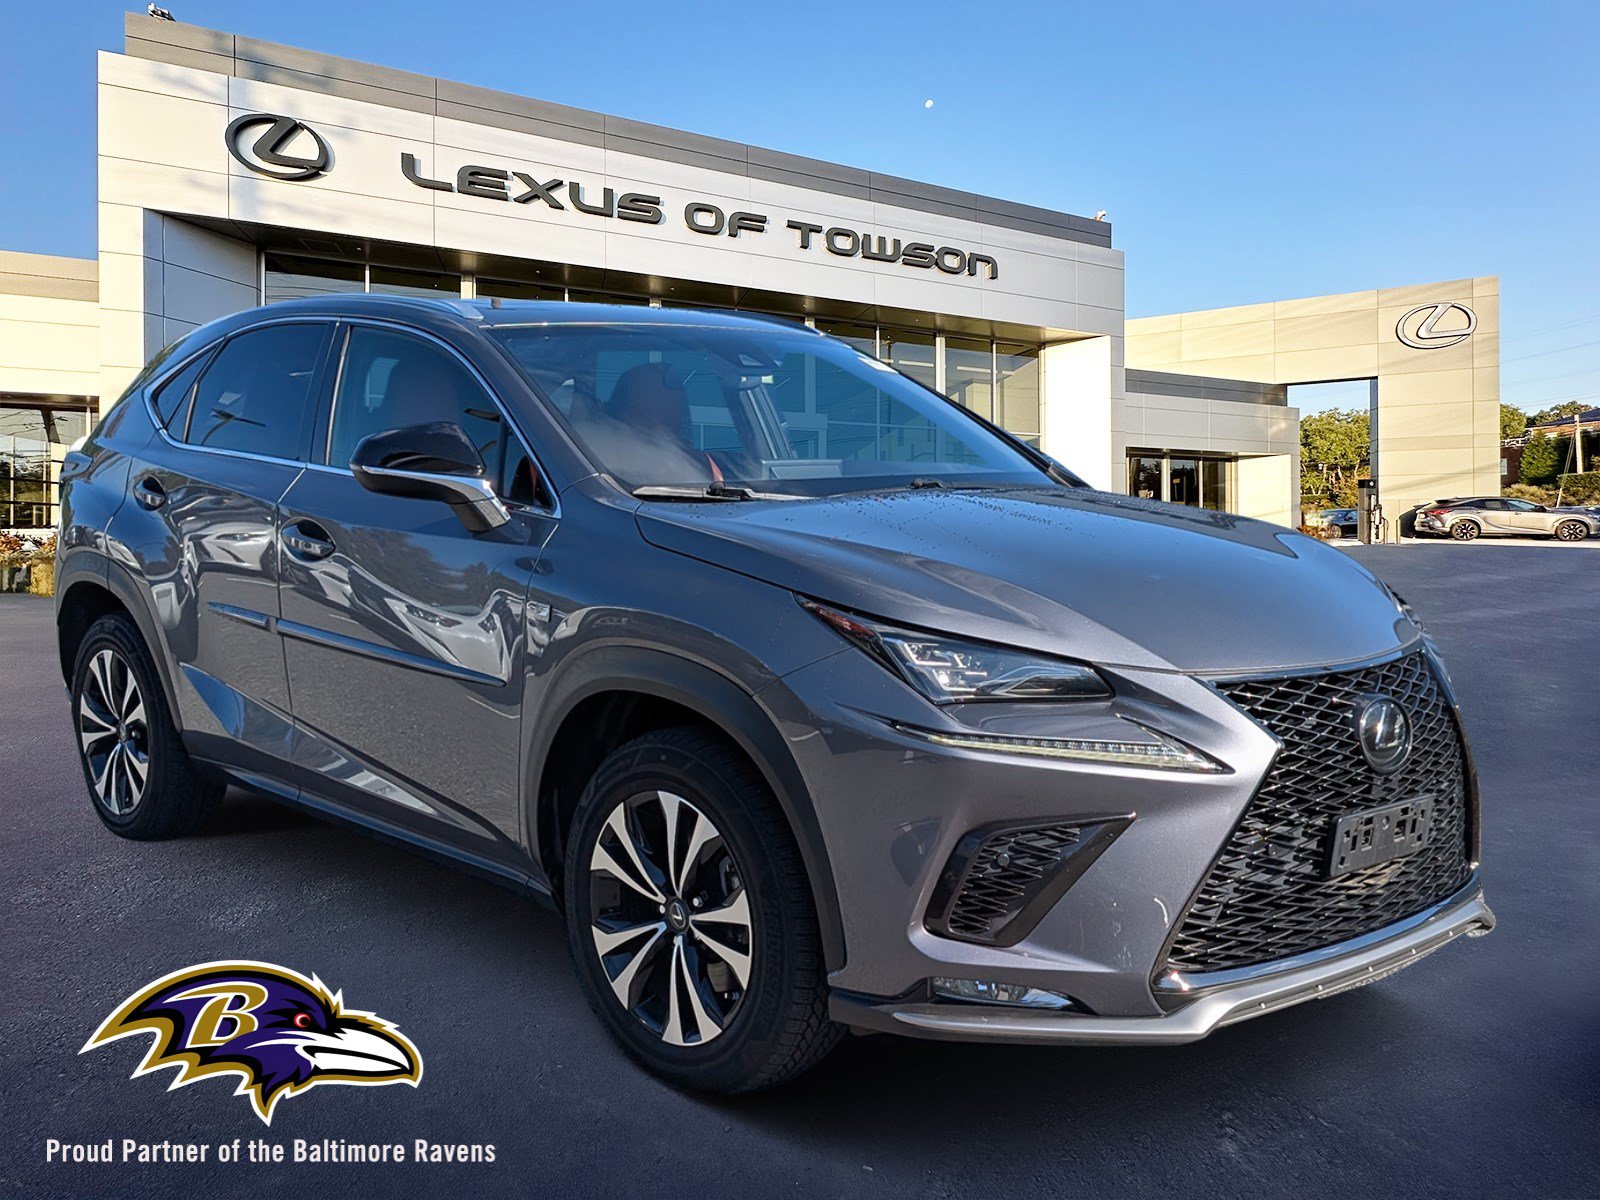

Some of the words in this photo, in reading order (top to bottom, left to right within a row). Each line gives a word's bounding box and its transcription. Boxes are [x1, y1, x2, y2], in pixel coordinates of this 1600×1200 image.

[401, 152, 662, 225] LEXUS
[685, 202, 768, 238] OF
[786, 219, 998, 280] TOWSON
